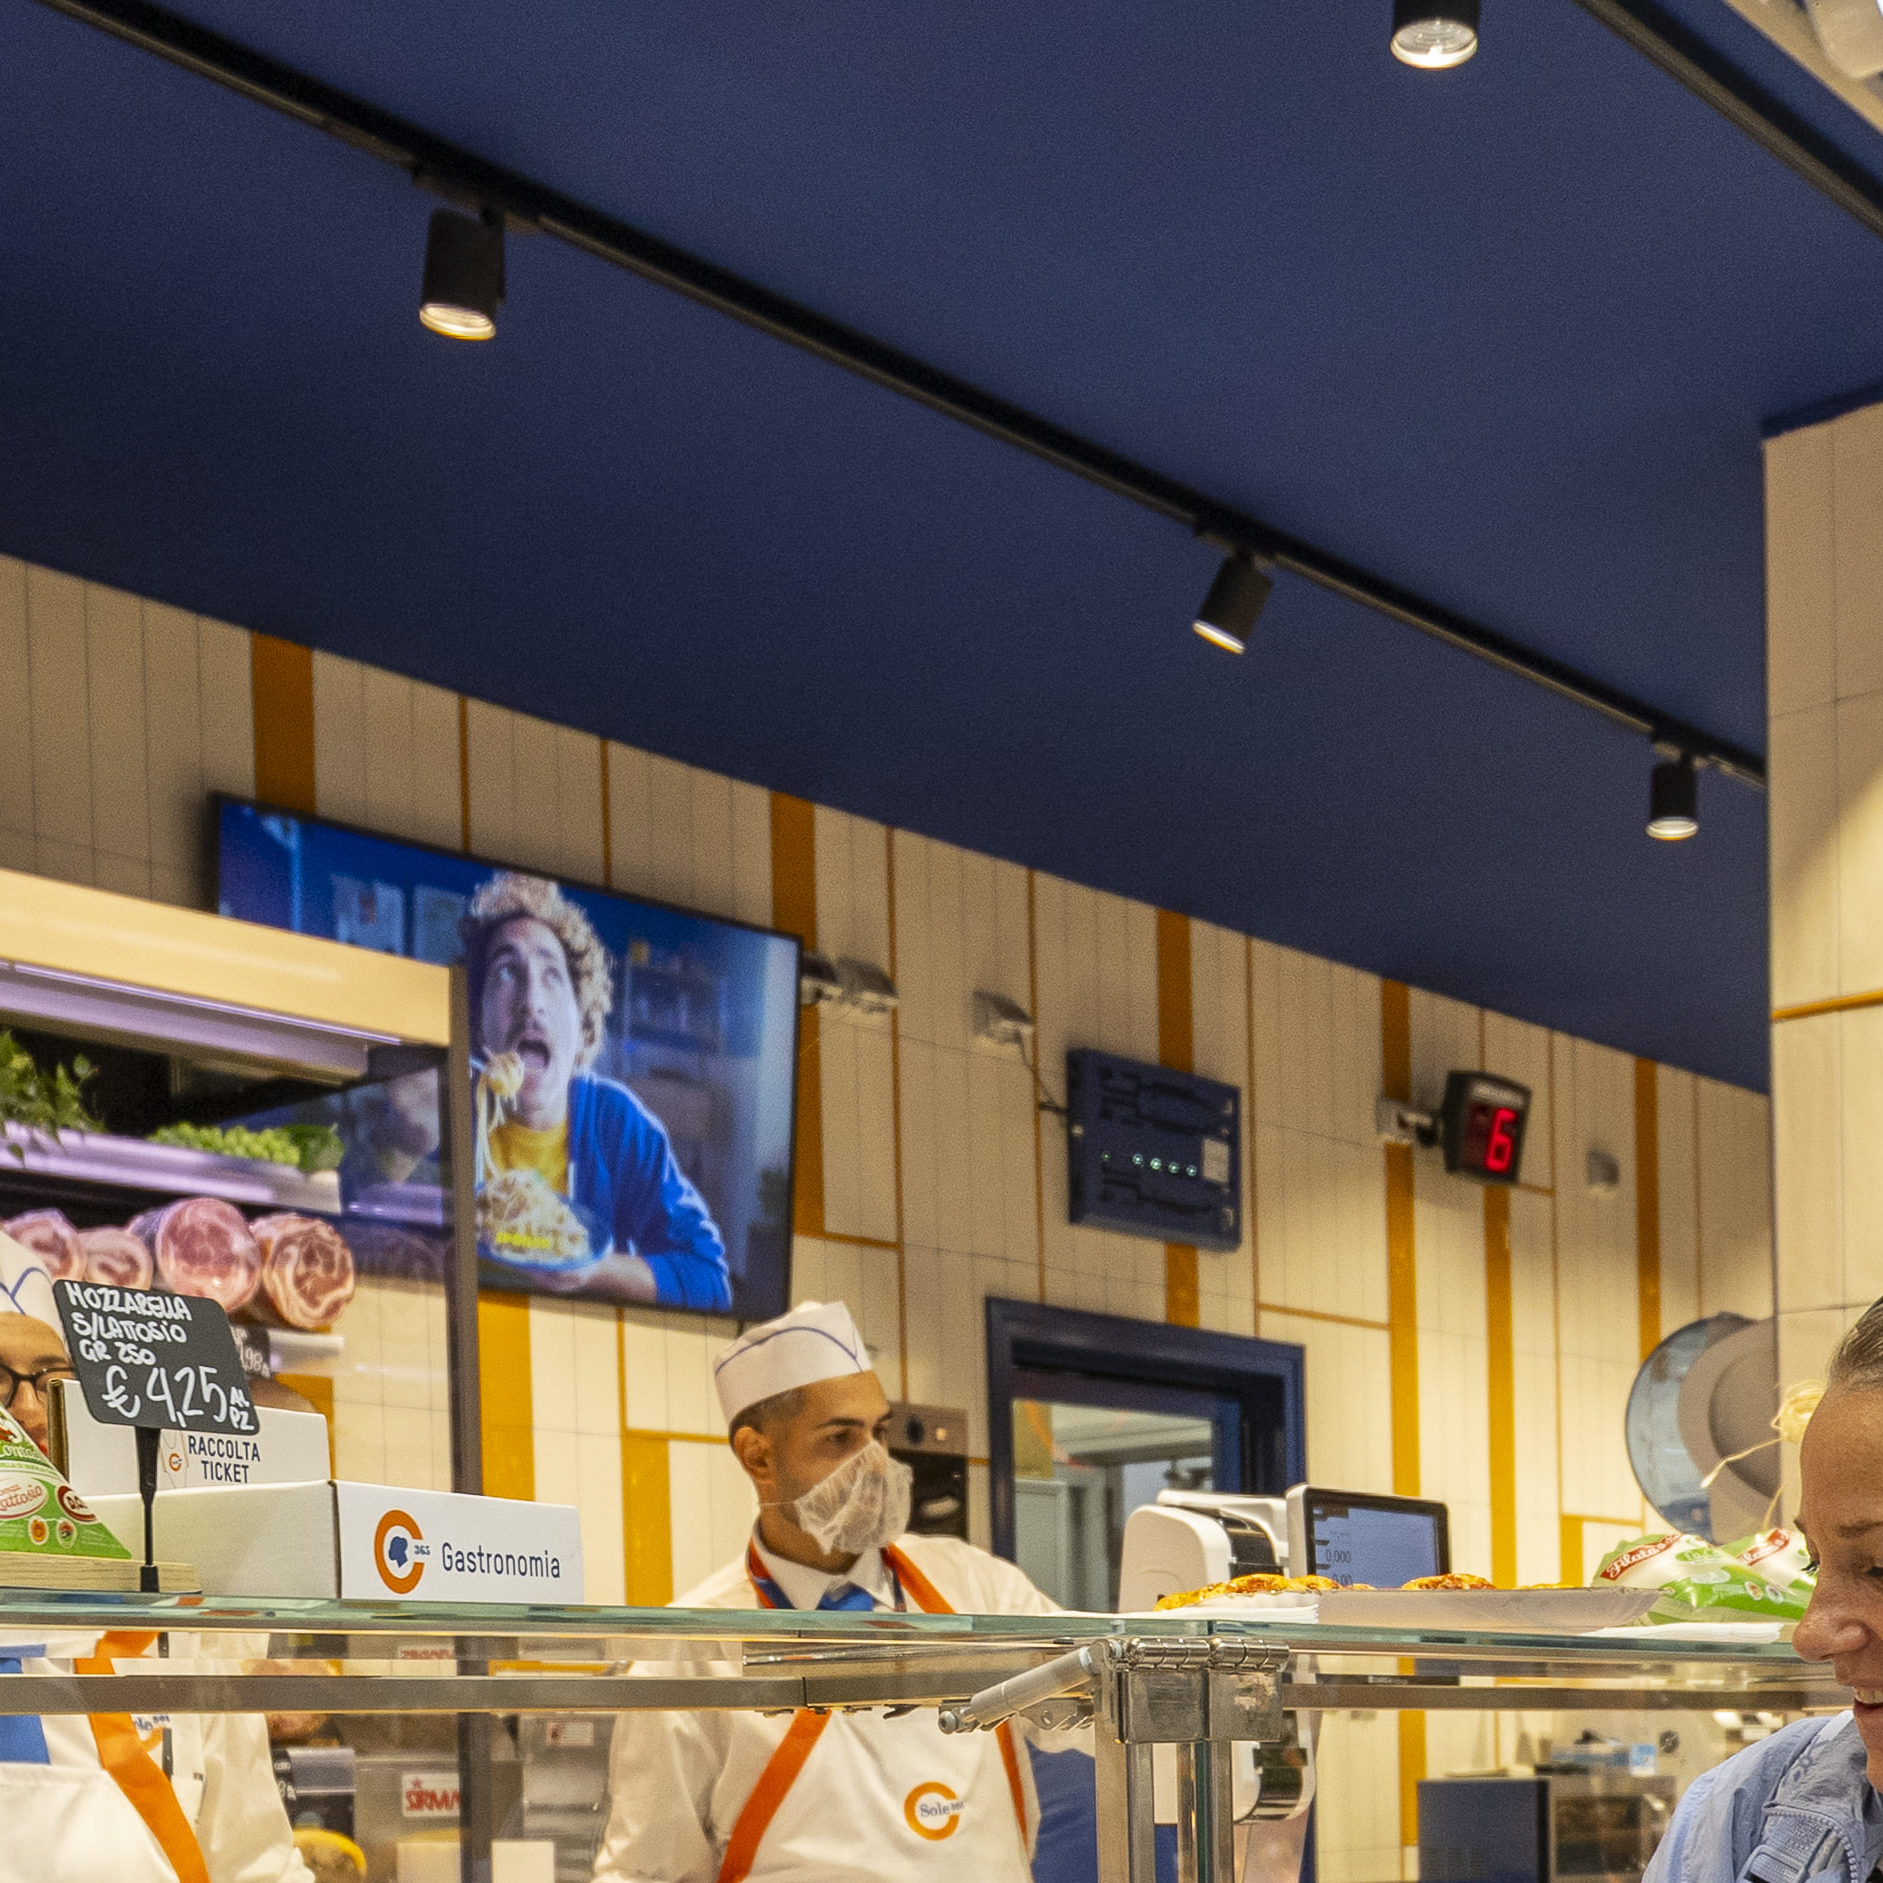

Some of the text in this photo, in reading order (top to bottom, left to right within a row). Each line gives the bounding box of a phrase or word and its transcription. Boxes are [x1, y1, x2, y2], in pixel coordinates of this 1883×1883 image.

[1482, 1107, 1516, 1174] 6
[65, 1281, 192, 1321] MOZZARELLA
[71, 1310, 188, 1343] S/LATTOSIO
[79, 1339, 156, 1366] GR 250
[102, 1365, 228, 1428] € 4,25
[229, 1406, 255, 1430] PZ
[188, 1435, 261, 1462] RACCOLTA
[201, 1459, 250, 1484] TICKET
[413, 1542, 561, 1578] 365 Gastronomia
[919, 1803, 951, 1818] Sole
